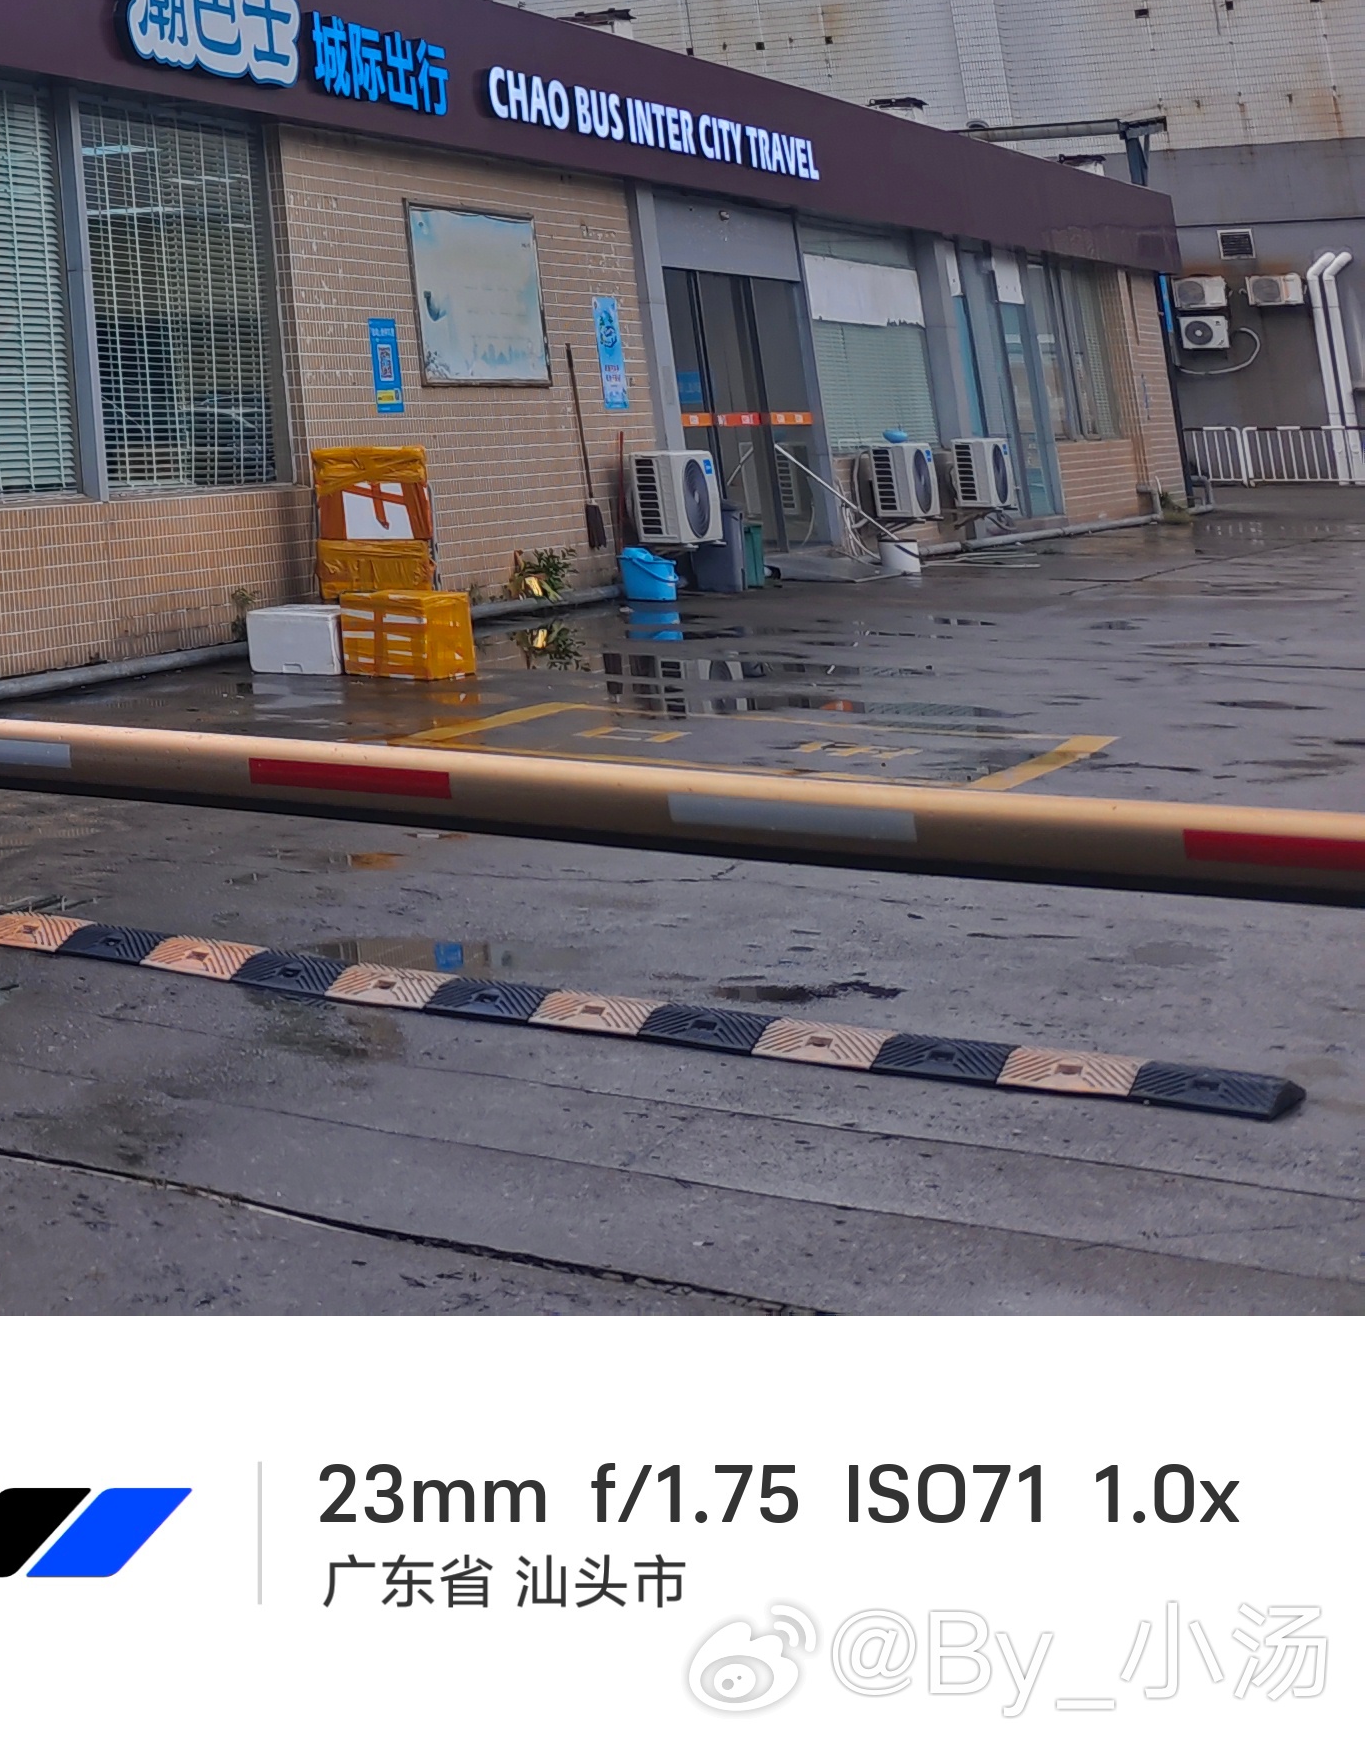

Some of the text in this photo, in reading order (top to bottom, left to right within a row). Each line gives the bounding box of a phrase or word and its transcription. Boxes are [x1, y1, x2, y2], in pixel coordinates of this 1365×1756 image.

[310, 10, 450, 116] 城际出行
[488, 66, 820, 181] CHAO BUS INTER CITY TRAVEL
